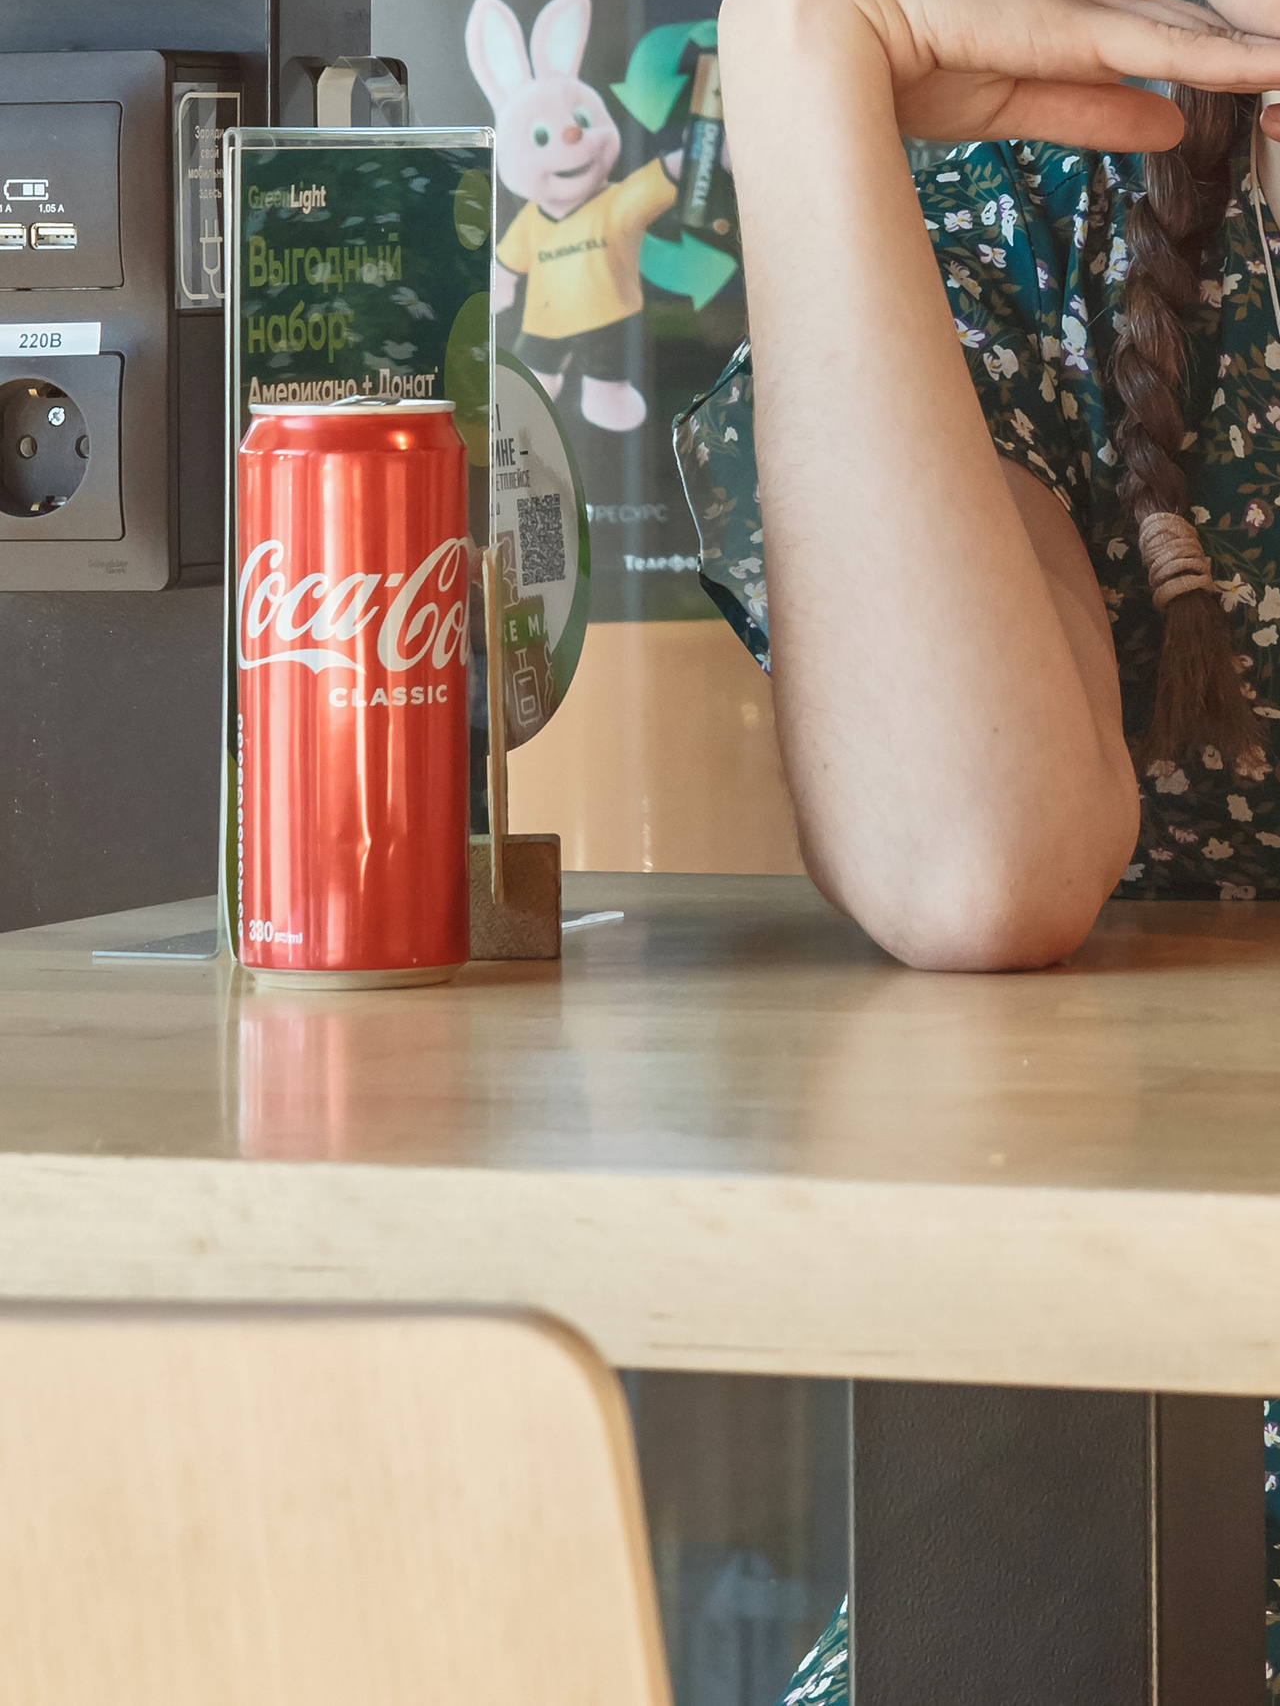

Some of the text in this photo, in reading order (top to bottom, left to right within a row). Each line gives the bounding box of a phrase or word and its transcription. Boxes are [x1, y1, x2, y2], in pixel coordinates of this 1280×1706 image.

[248, 232, 403, 294] Выгодный
[328, 684, 449, 709] CLASSIC
[249, 920, 273, 943] 330
